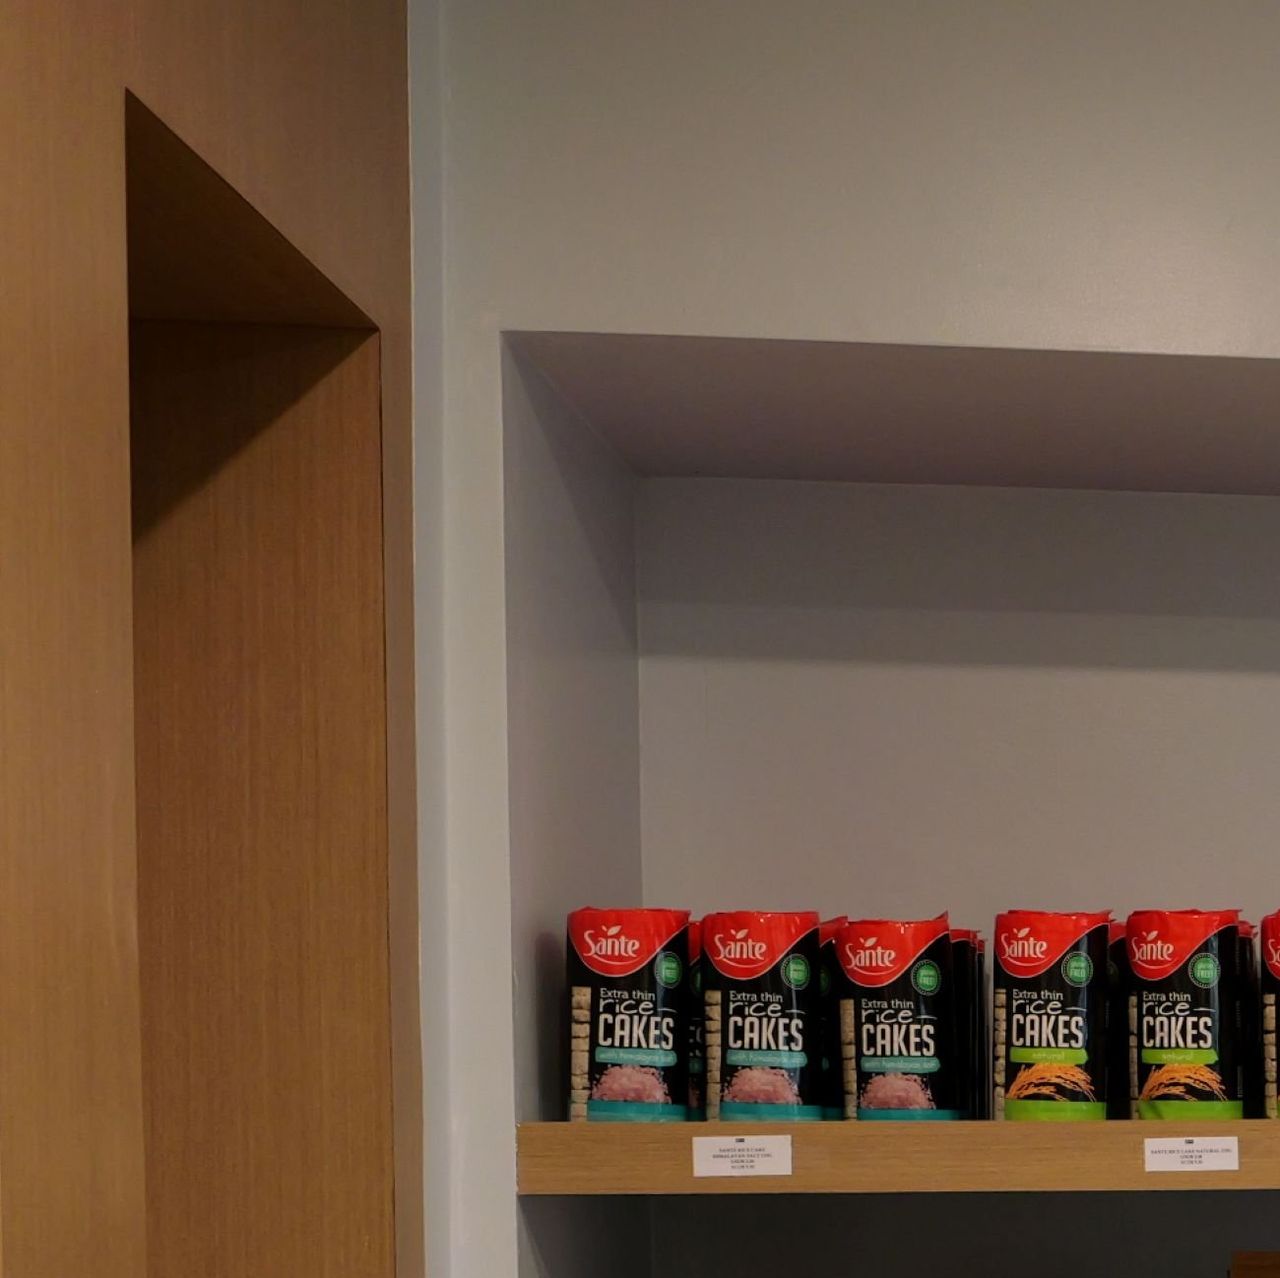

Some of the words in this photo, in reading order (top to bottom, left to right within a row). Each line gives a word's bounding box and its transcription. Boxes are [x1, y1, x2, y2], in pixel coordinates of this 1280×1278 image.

[583, 929, 641, 958] Sante
[714, 934, 767, 960] Sante
[1001, 933, 1047, 959] Sante
[1132, 936, 1175, 962] Sante
[845, 943, 896, 968] Sante
[600, 987, 629, 999] Extra
[632, 989, 656, 1001] thin
[729, 991, 757, 1001] Extra
[760, 992, 783, 1003] thin
[861, 998, 889, 1009] Extra
[891, 999, 914, 1009] thin
[1012, 989, 1038, 1000] Extra
[1040, 989, 1063, 1001] thin
[1143, 991, 1166, 1001] Extra
[1169, 991, 1191, 1002] thin
[599, 999, 655, 1015] rice
[729, 1001, 783, 1017] rice
[861, 1009, 913, 1023] rice
[1012, 1000, 1062, 1014] rice
[1143, 1001, 1190, 1016] rice
[598, 1014, 675, 1050] CAKES
[728, 1016, 803, 1051] CAKES
[862, 1023, 935, 1057] CAKES
[1012, 1014, 1084, 1048] CAKES
[1142, 1016, 1212, 1049] CAKES
